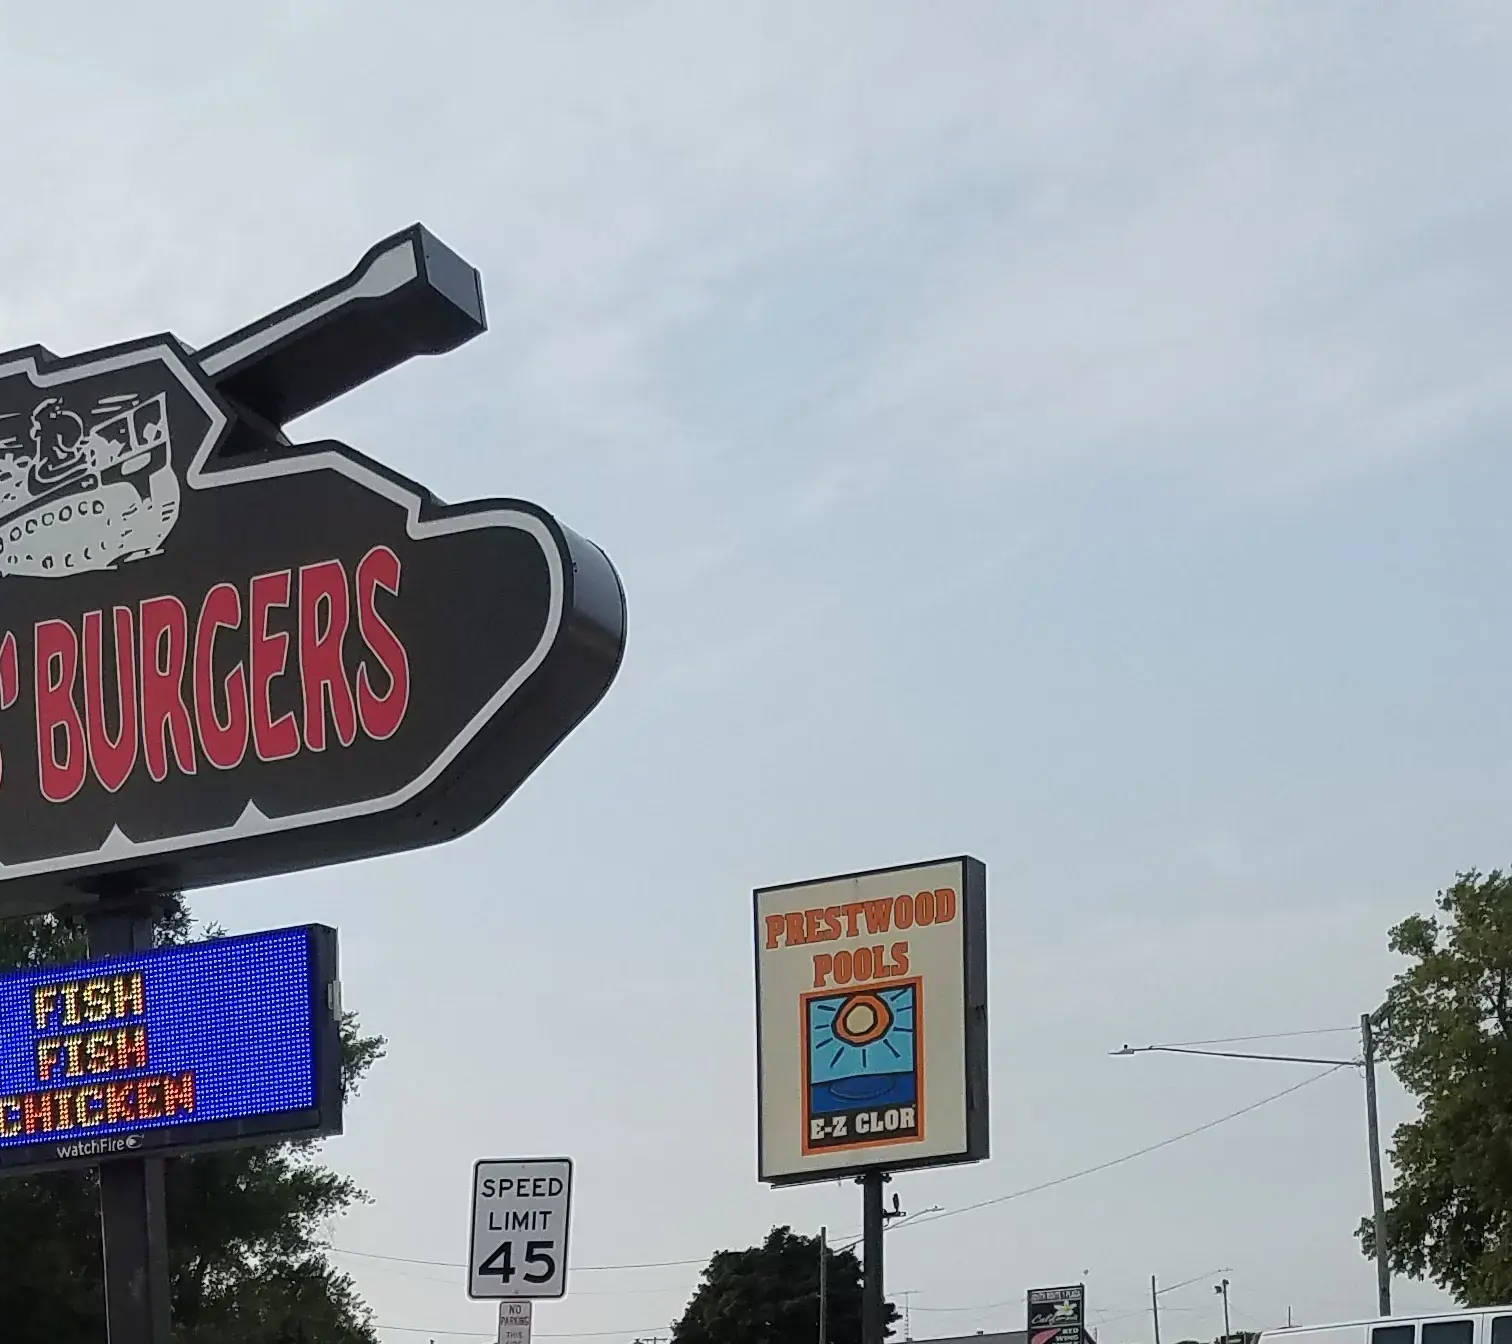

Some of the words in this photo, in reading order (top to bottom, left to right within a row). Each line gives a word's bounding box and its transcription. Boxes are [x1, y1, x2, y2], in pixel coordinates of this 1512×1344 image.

[33, 545, 410, 805] BURGERS
[766, 888, 956, 949] PRESTWOOD
[813, 942, 909, 988] POOLS
[34, 971, 145, 1029] FISH
[37, 1024, 149, 1081] FISH
[811, 1115, 848, 1140] E-Z
[855, 1107, 915, 1134] CLOR
[481, 1178, 563, 1198] SPEED
[489, 1211, 552, 1231] LIMIT
[478, 1240, 556, 1284] 45
[500, 1316, 530, 1327] PARKING
[509, 1304, 521, 1314] NO
